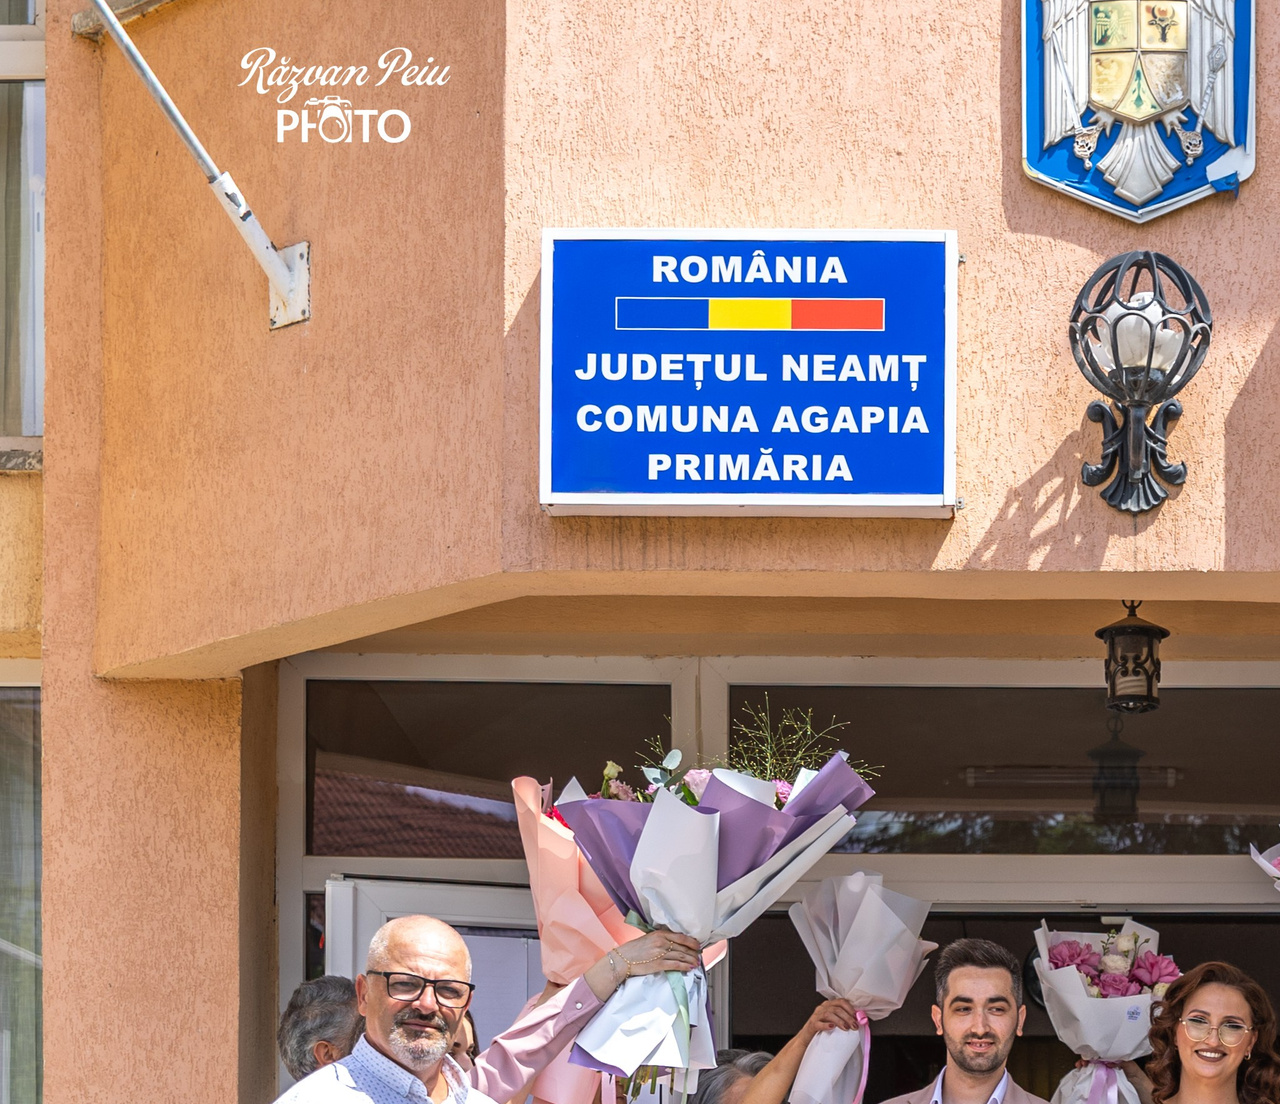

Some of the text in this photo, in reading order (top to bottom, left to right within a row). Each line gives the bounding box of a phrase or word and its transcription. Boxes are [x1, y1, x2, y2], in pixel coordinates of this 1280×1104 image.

[652, 249, 848, 284] ROMÂNIA
[574, 353, 927, 392] JUDEȚUL NEAMȚ
[576, 404, 930, 434] COMUNA AGAPIA
[647, 447, 854, 482] PRIMĂRIA
